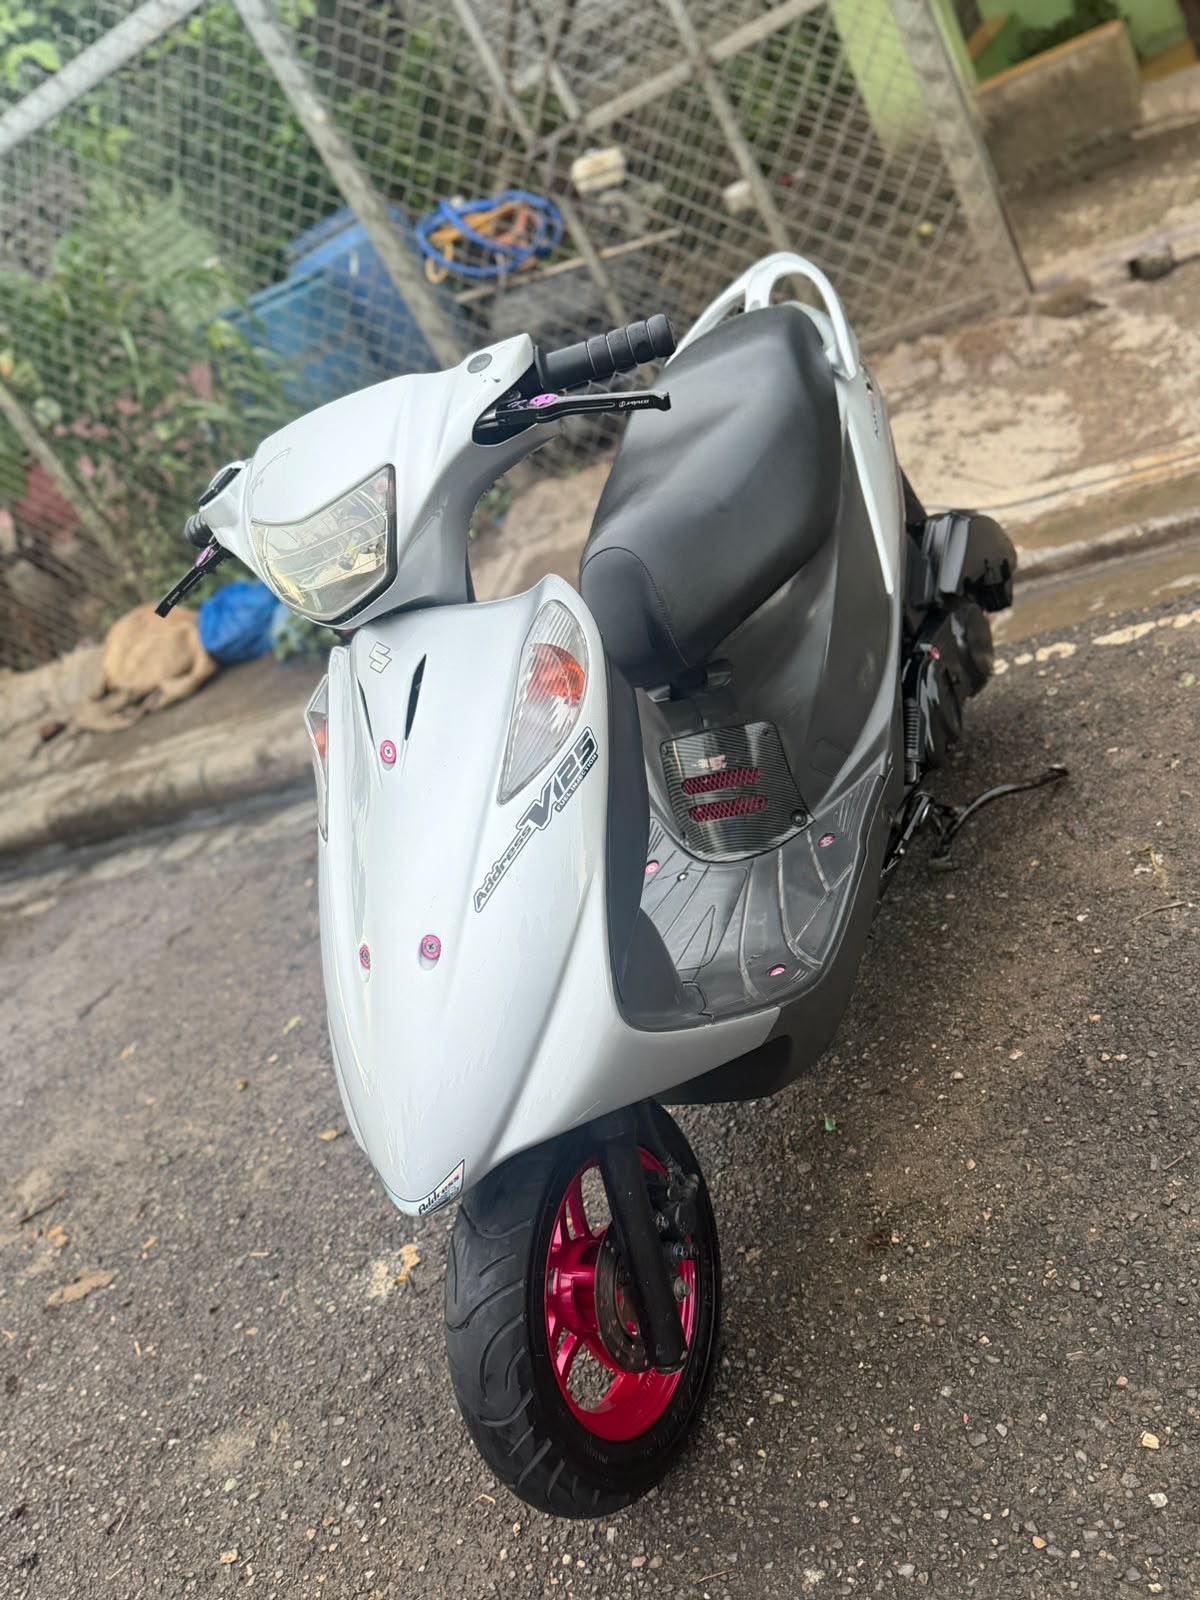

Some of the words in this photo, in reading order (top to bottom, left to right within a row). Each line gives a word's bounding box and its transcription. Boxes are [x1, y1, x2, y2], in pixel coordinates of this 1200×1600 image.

[474, 824, 532, 911] Address
[518, 728, 598, 829] V125
[555, 789, 573, 811] FUEL
[569, 753, 598, 791] INJECTION
